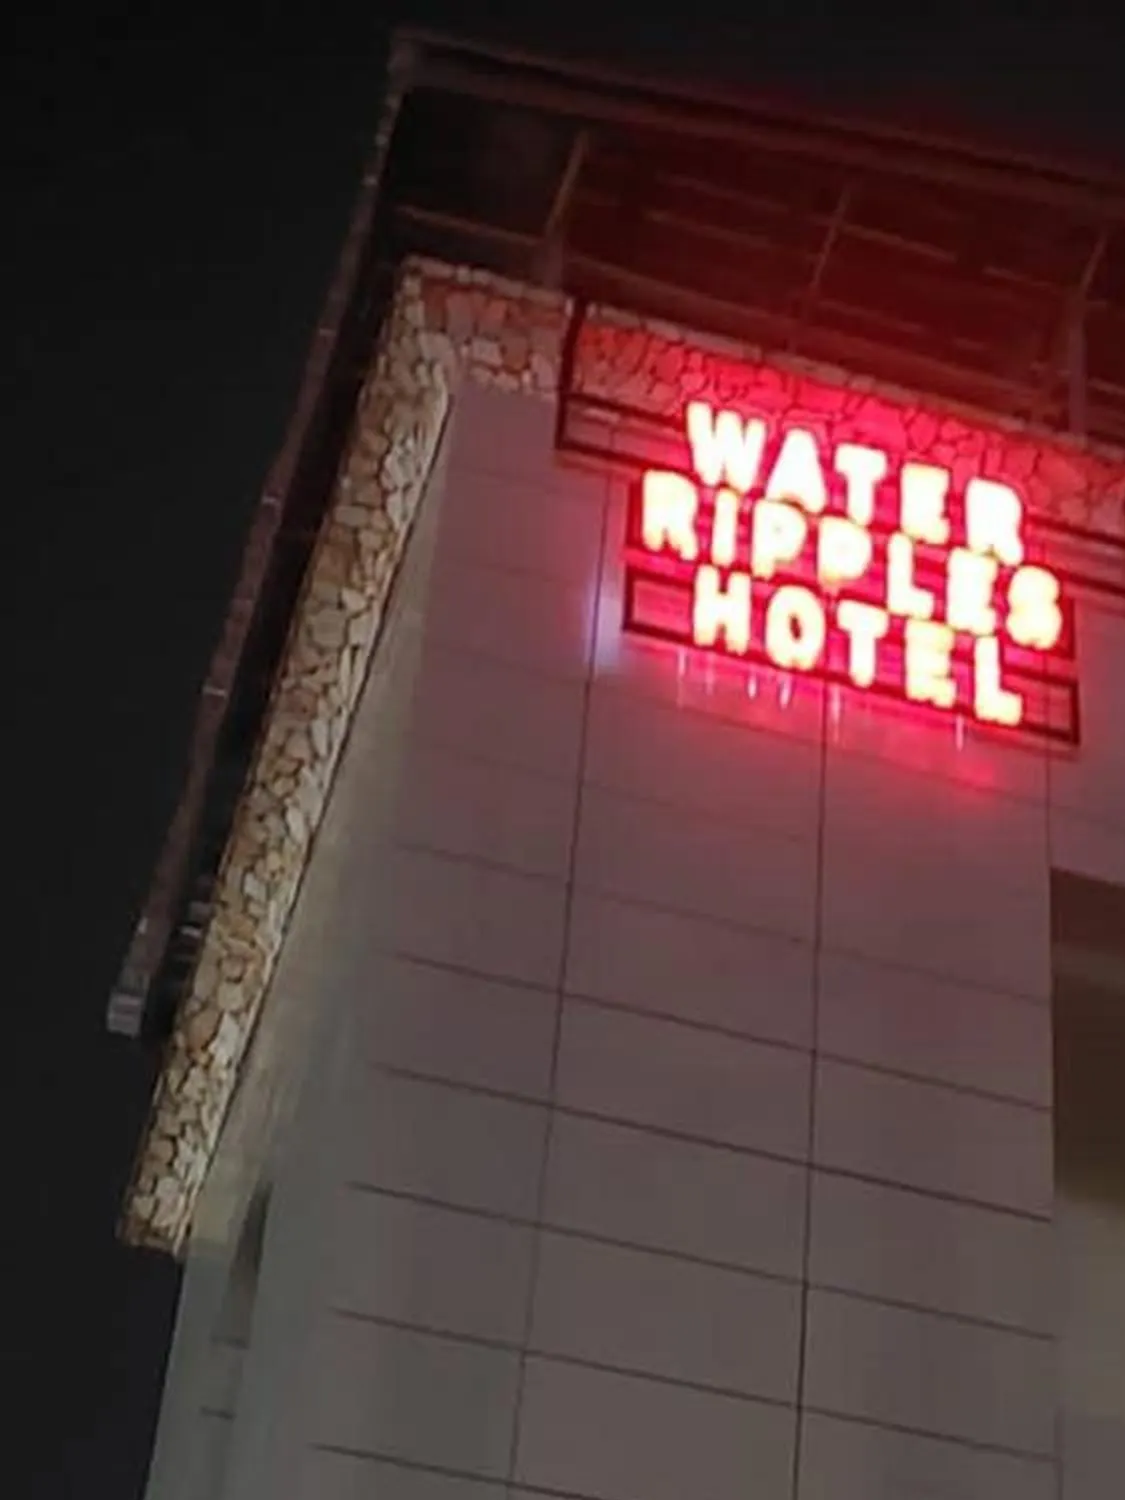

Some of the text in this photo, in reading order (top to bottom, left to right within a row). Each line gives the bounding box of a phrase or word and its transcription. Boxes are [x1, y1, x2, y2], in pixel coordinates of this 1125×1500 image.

[641, 469, 1063, 650] RIPPLES
[686, 401, 1024, 566] WATER
[693, 565, 1023, 726] HOTEL
